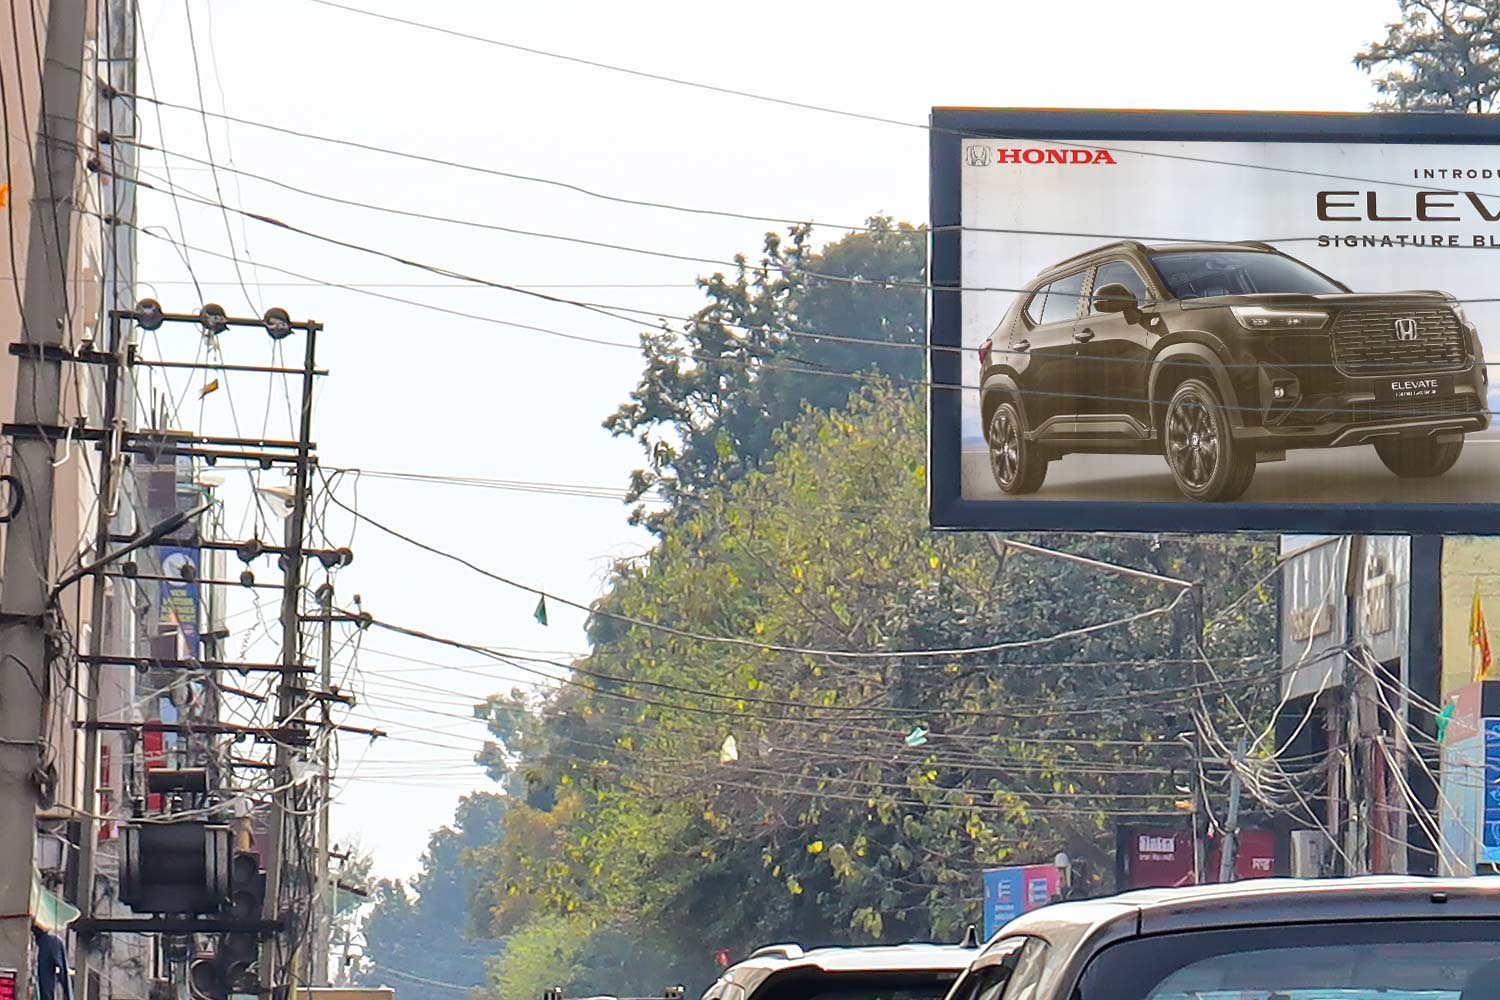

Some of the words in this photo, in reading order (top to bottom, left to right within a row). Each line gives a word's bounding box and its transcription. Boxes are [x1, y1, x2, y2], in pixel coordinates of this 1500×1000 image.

[997, 148, 1117, 164] HONDA
[1317, 235, 1459, 247] SIGNATURE
[1391, 379, 1438, 390] ELEVATE
